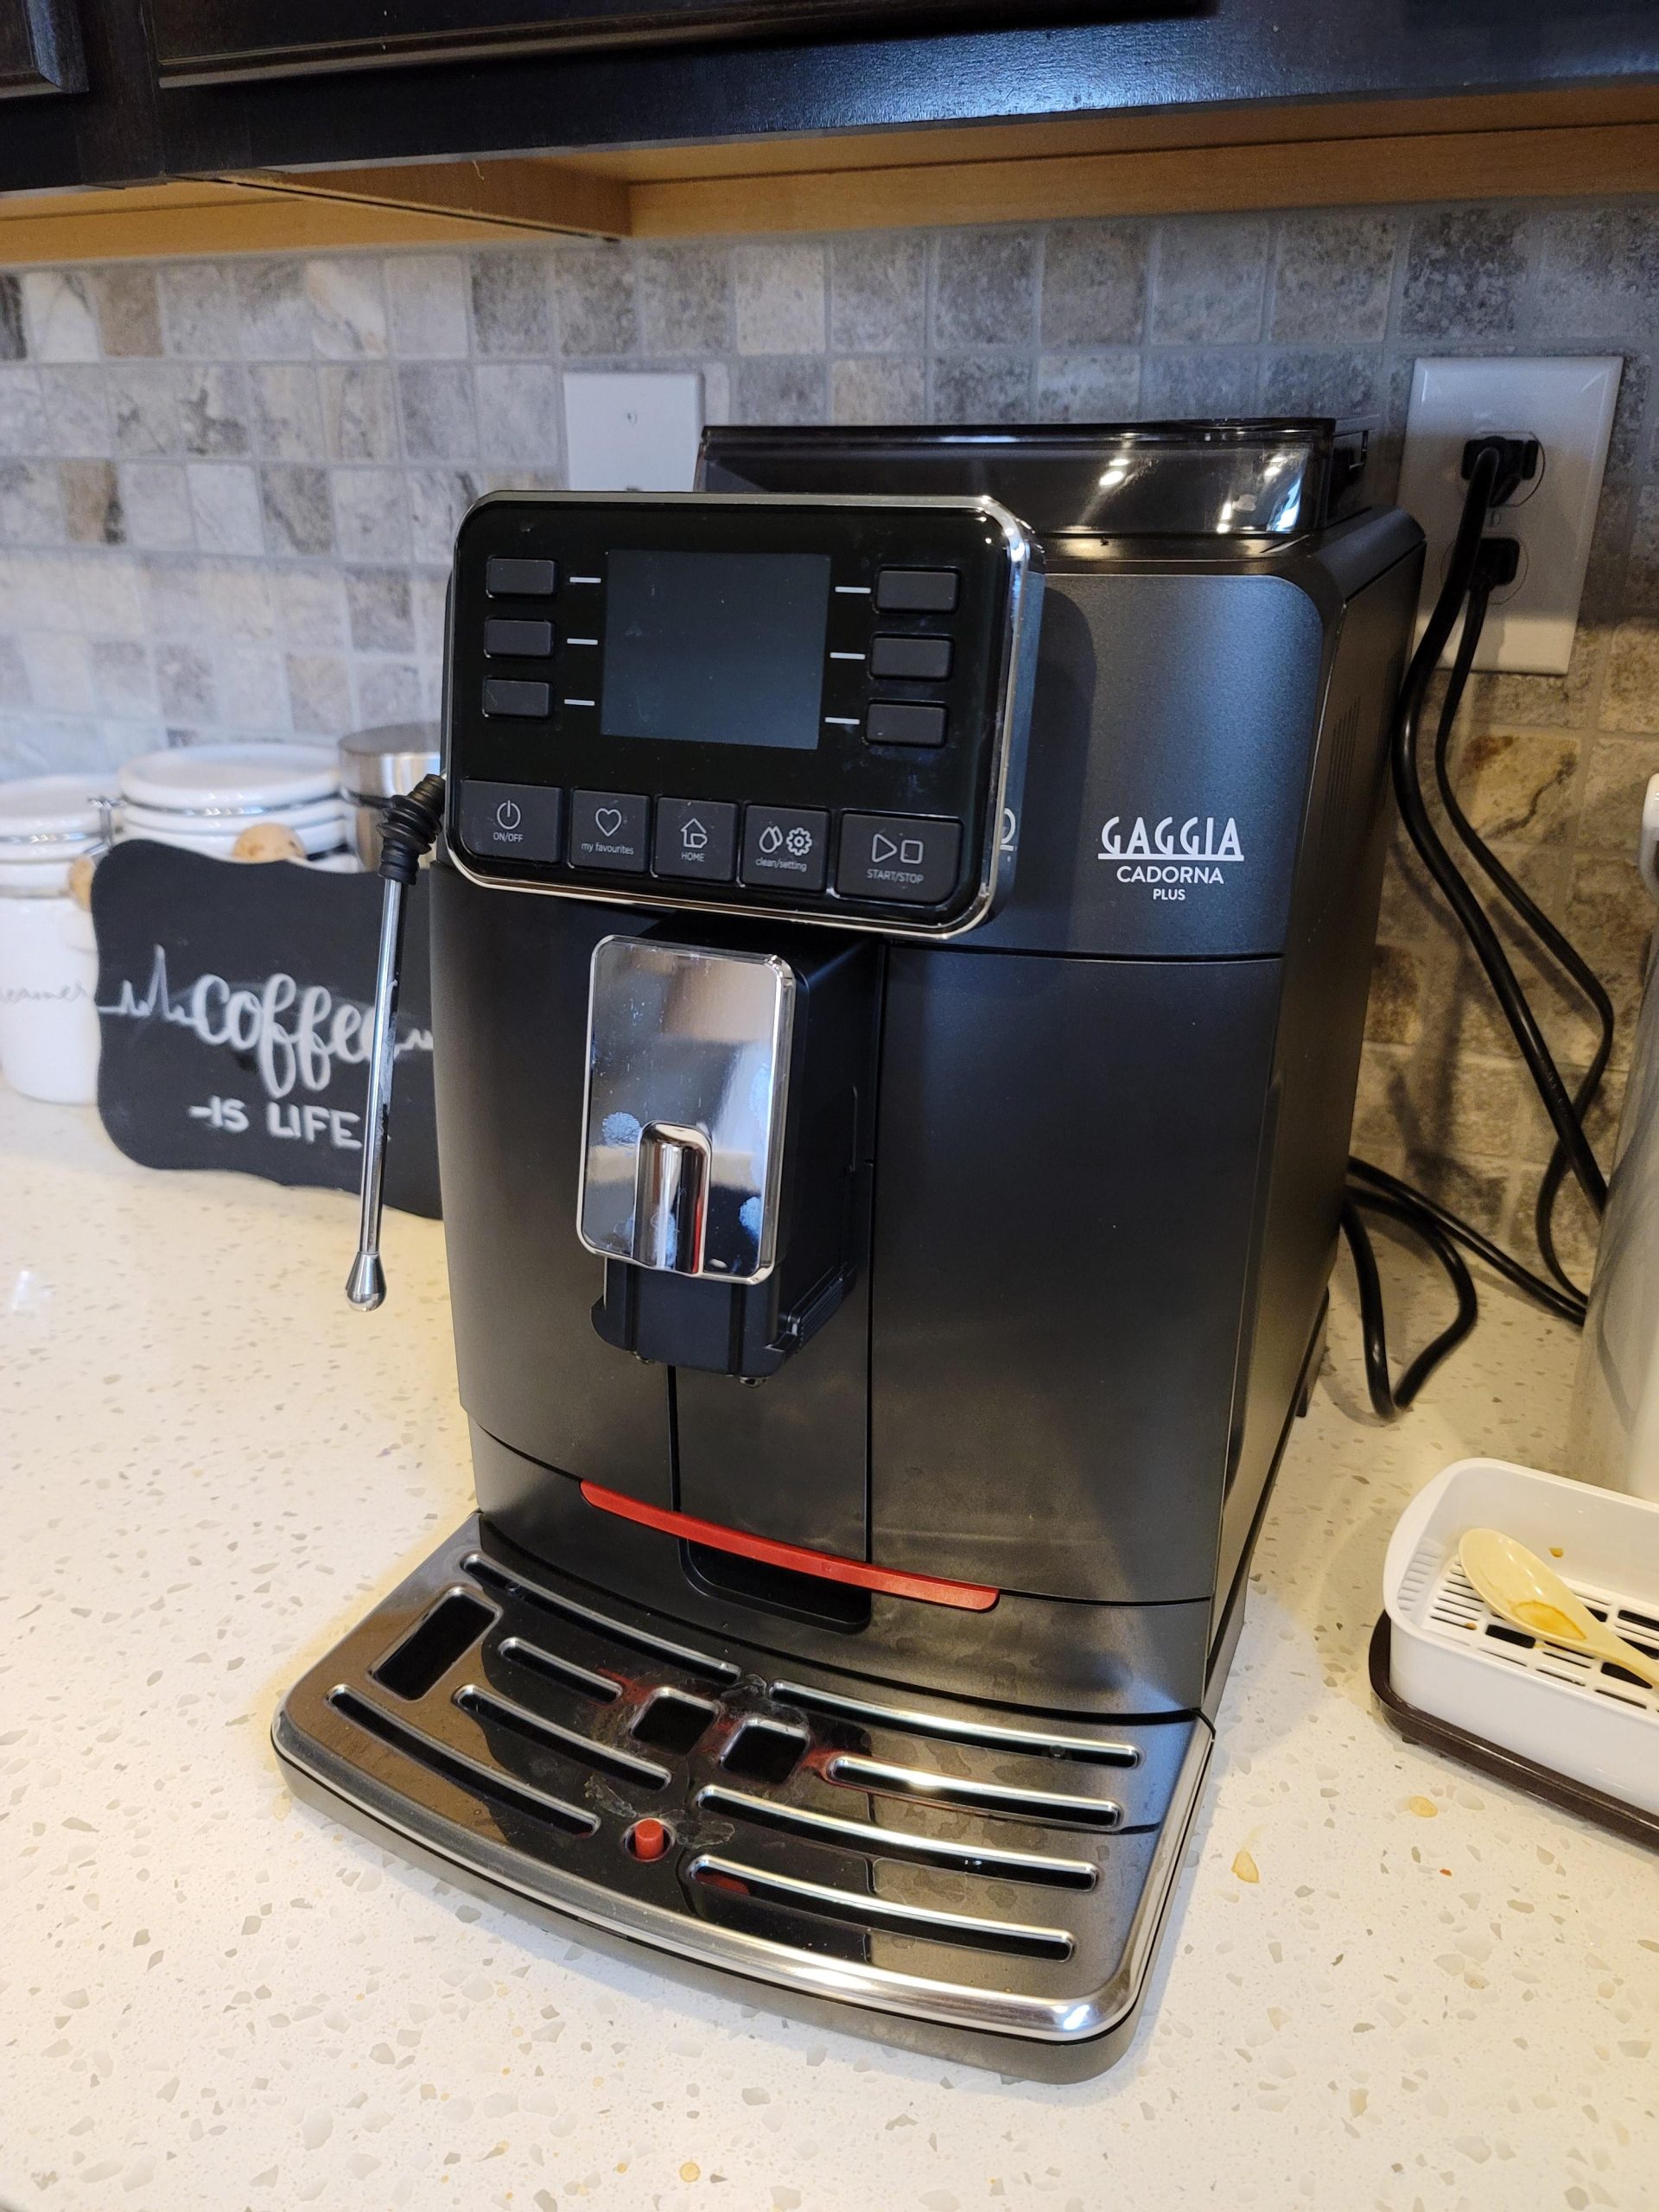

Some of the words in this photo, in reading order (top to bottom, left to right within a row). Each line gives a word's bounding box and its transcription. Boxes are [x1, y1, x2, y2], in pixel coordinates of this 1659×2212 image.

[493, 831, 524, 842] ON/OFF
[1099, 816, 1243, 860] GAGGIA
[581, 842, 594, 853] my
[595, 842, 634, 855] favourites
[681, 851, 705, 861] HOME
[755, 857, 807, 872] clean/setting
[866, 868, 924, 883] START/STOP
[1116, 865, 1224, 885] CADORNA
[1153, 888, 1185, 900] PLUS
[265, 1101, 363, 1149] LIFE
